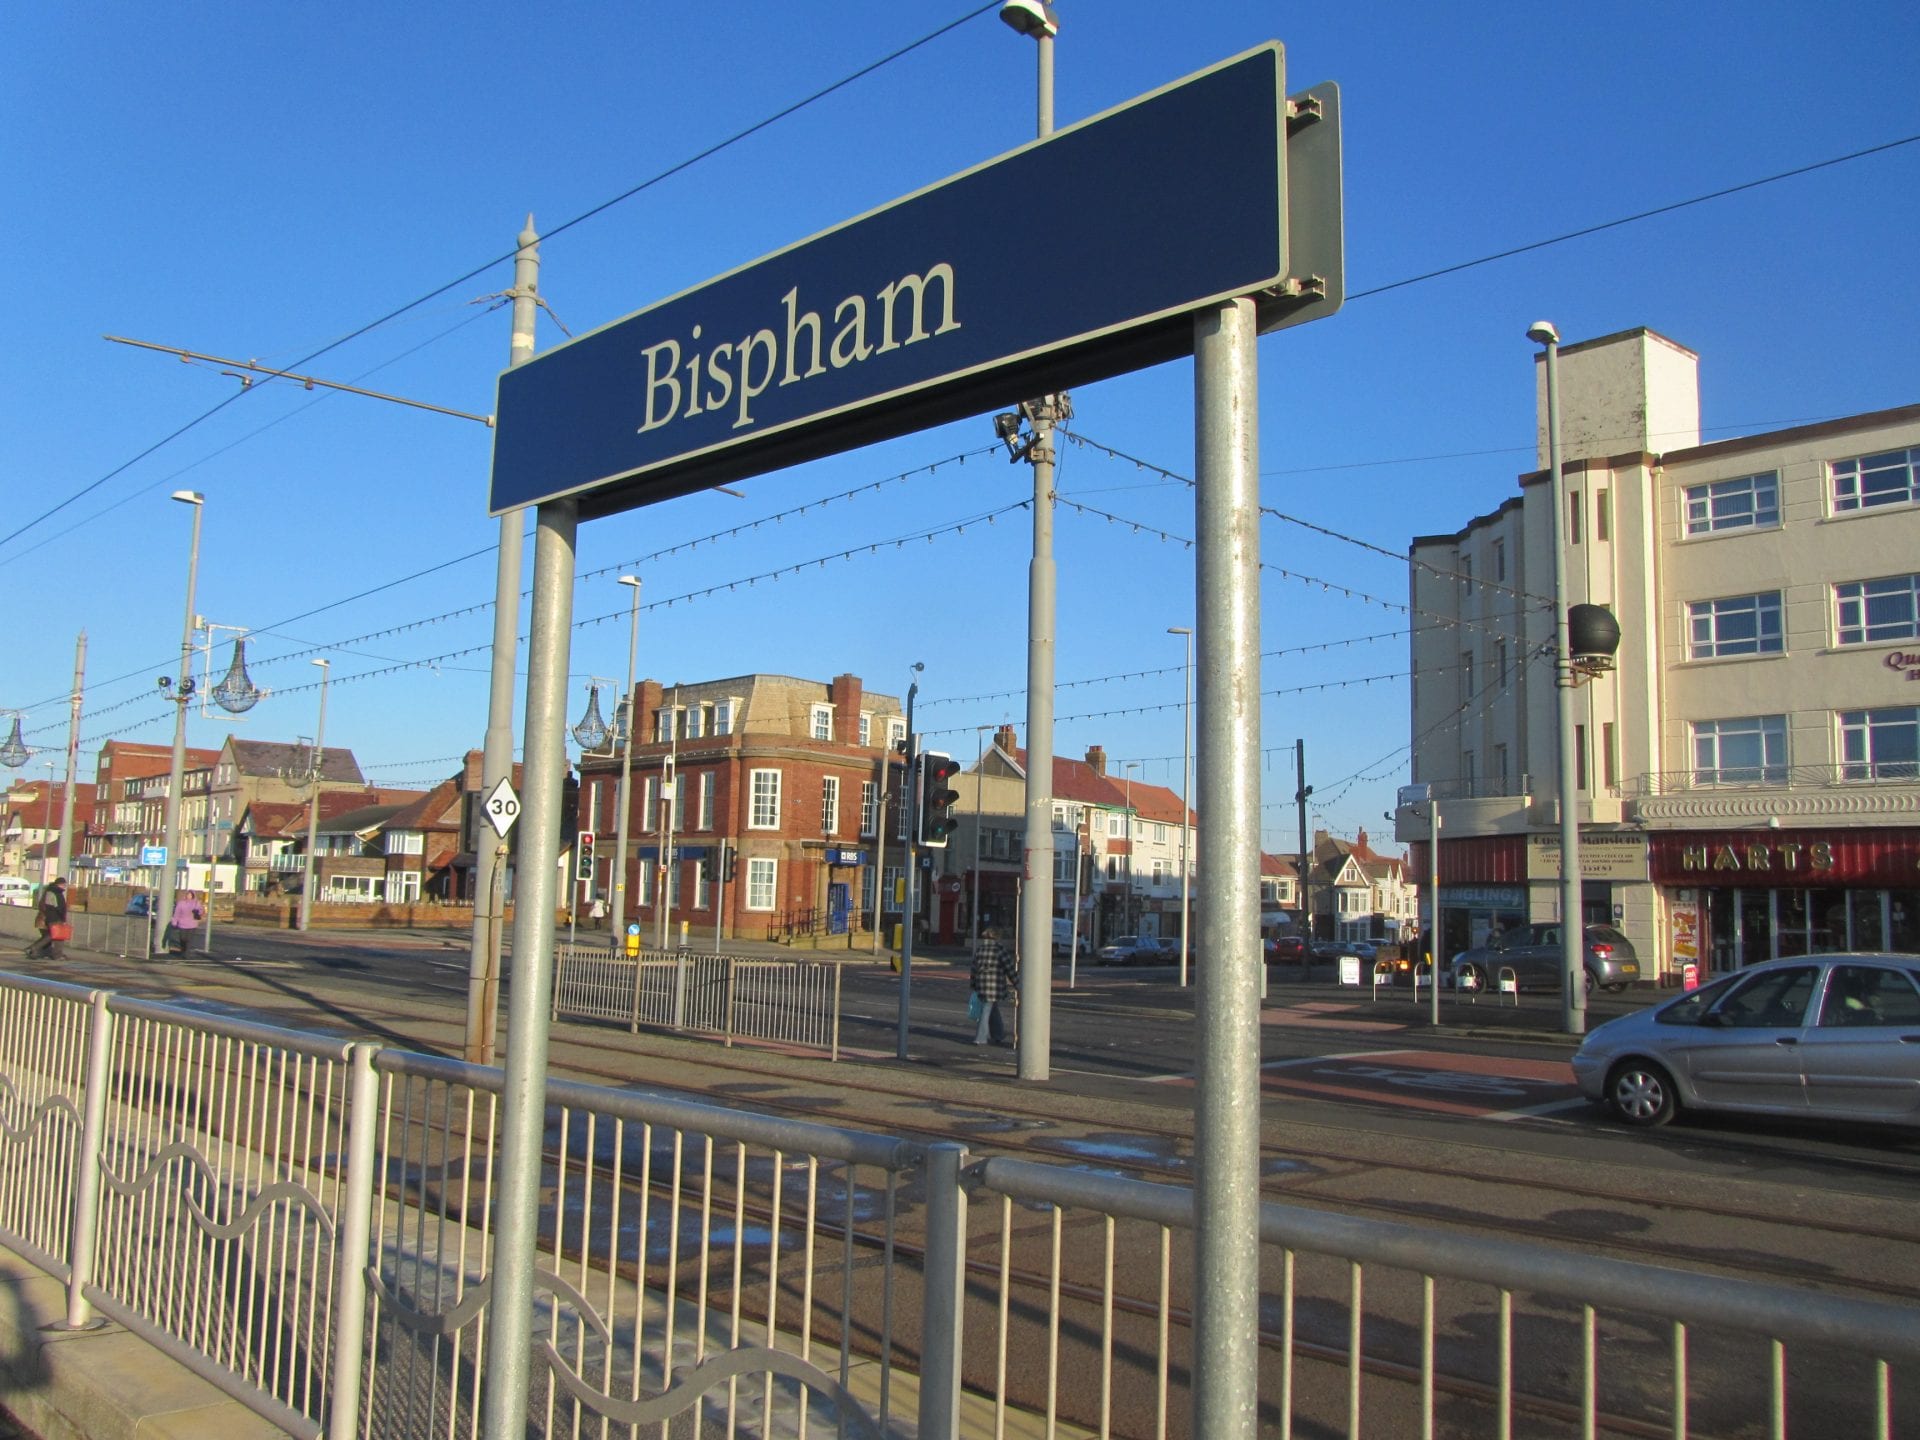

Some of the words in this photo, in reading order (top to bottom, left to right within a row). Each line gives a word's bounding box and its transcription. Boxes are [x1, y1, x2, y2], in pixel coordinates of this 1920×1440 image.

[637, 262, 962, 435] Bispham
[492, 799, 517, 816] 30
[1682, 841, 1835, 872] HARTS
